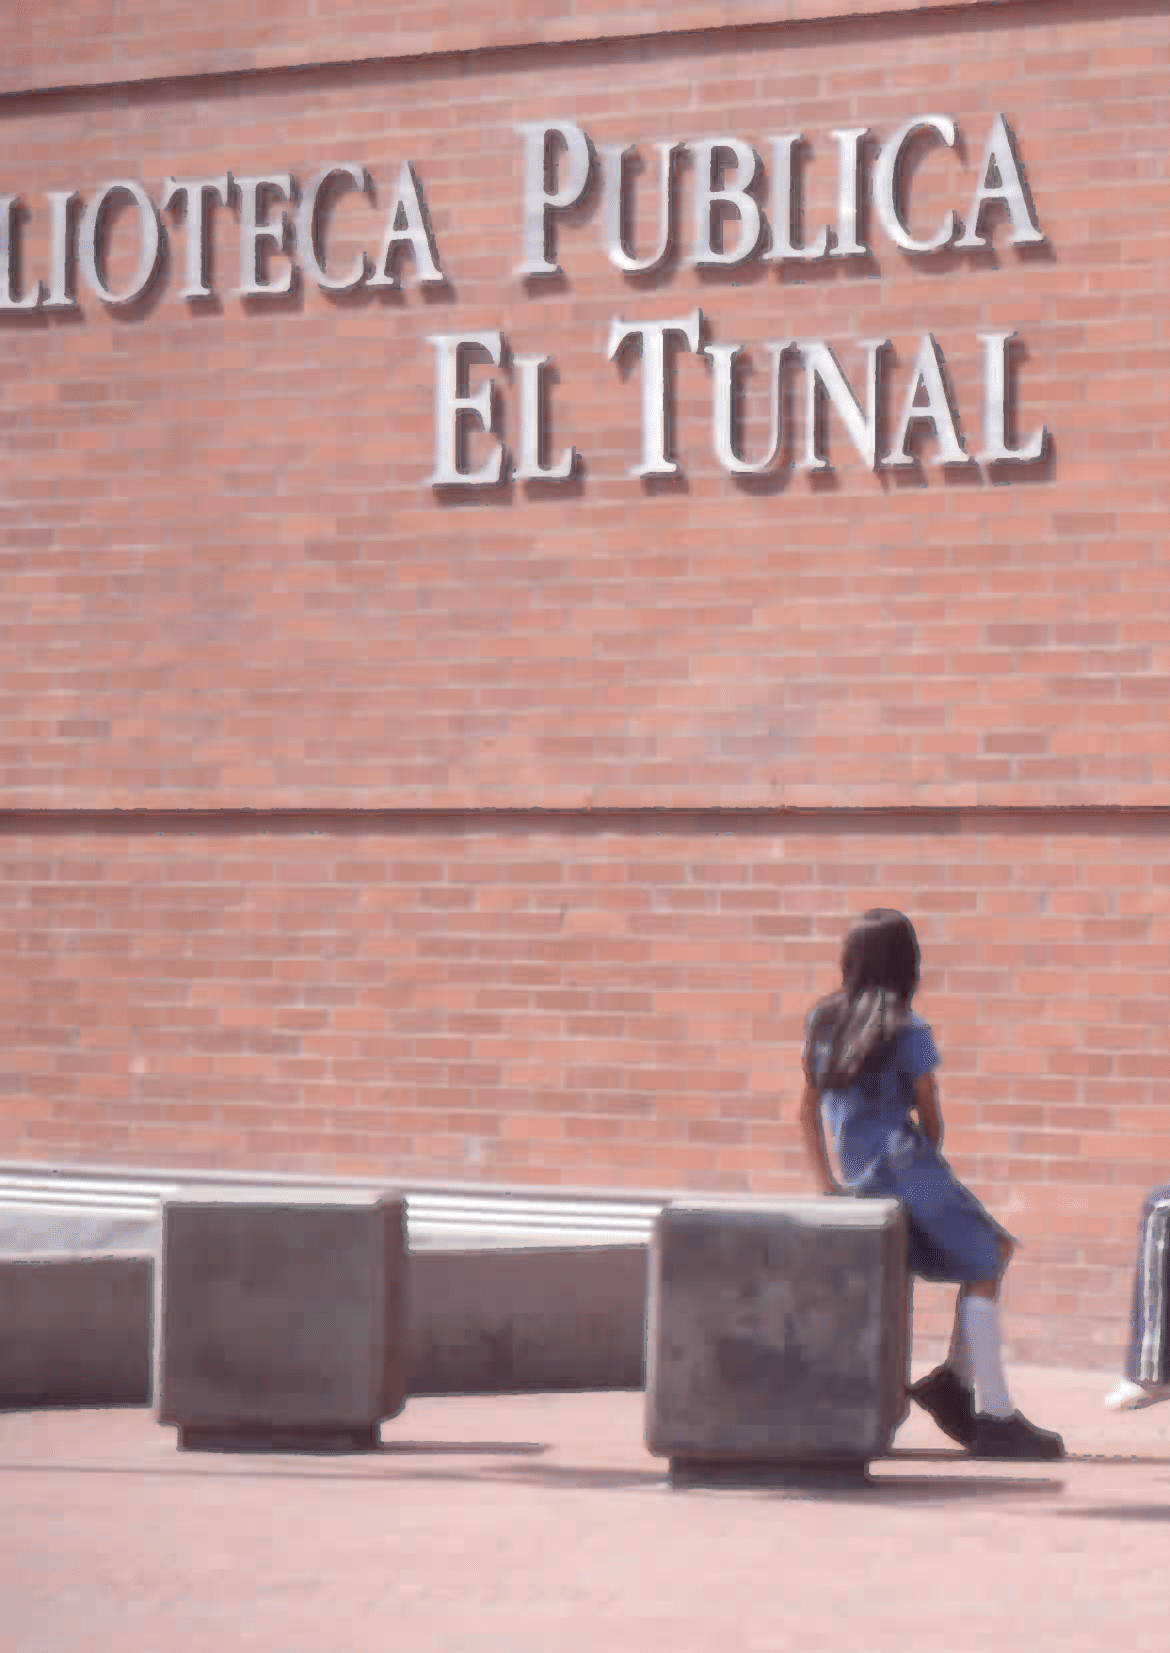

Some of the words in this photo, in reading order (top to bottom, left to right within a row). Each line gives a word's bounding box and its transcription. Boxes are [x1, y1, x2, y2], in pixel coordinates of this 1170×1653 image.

[514, 113, 1046, 275] PUBLICA
[426, 331, 581, 486] EL
[607, 308, 1047, 475] TUNAL
